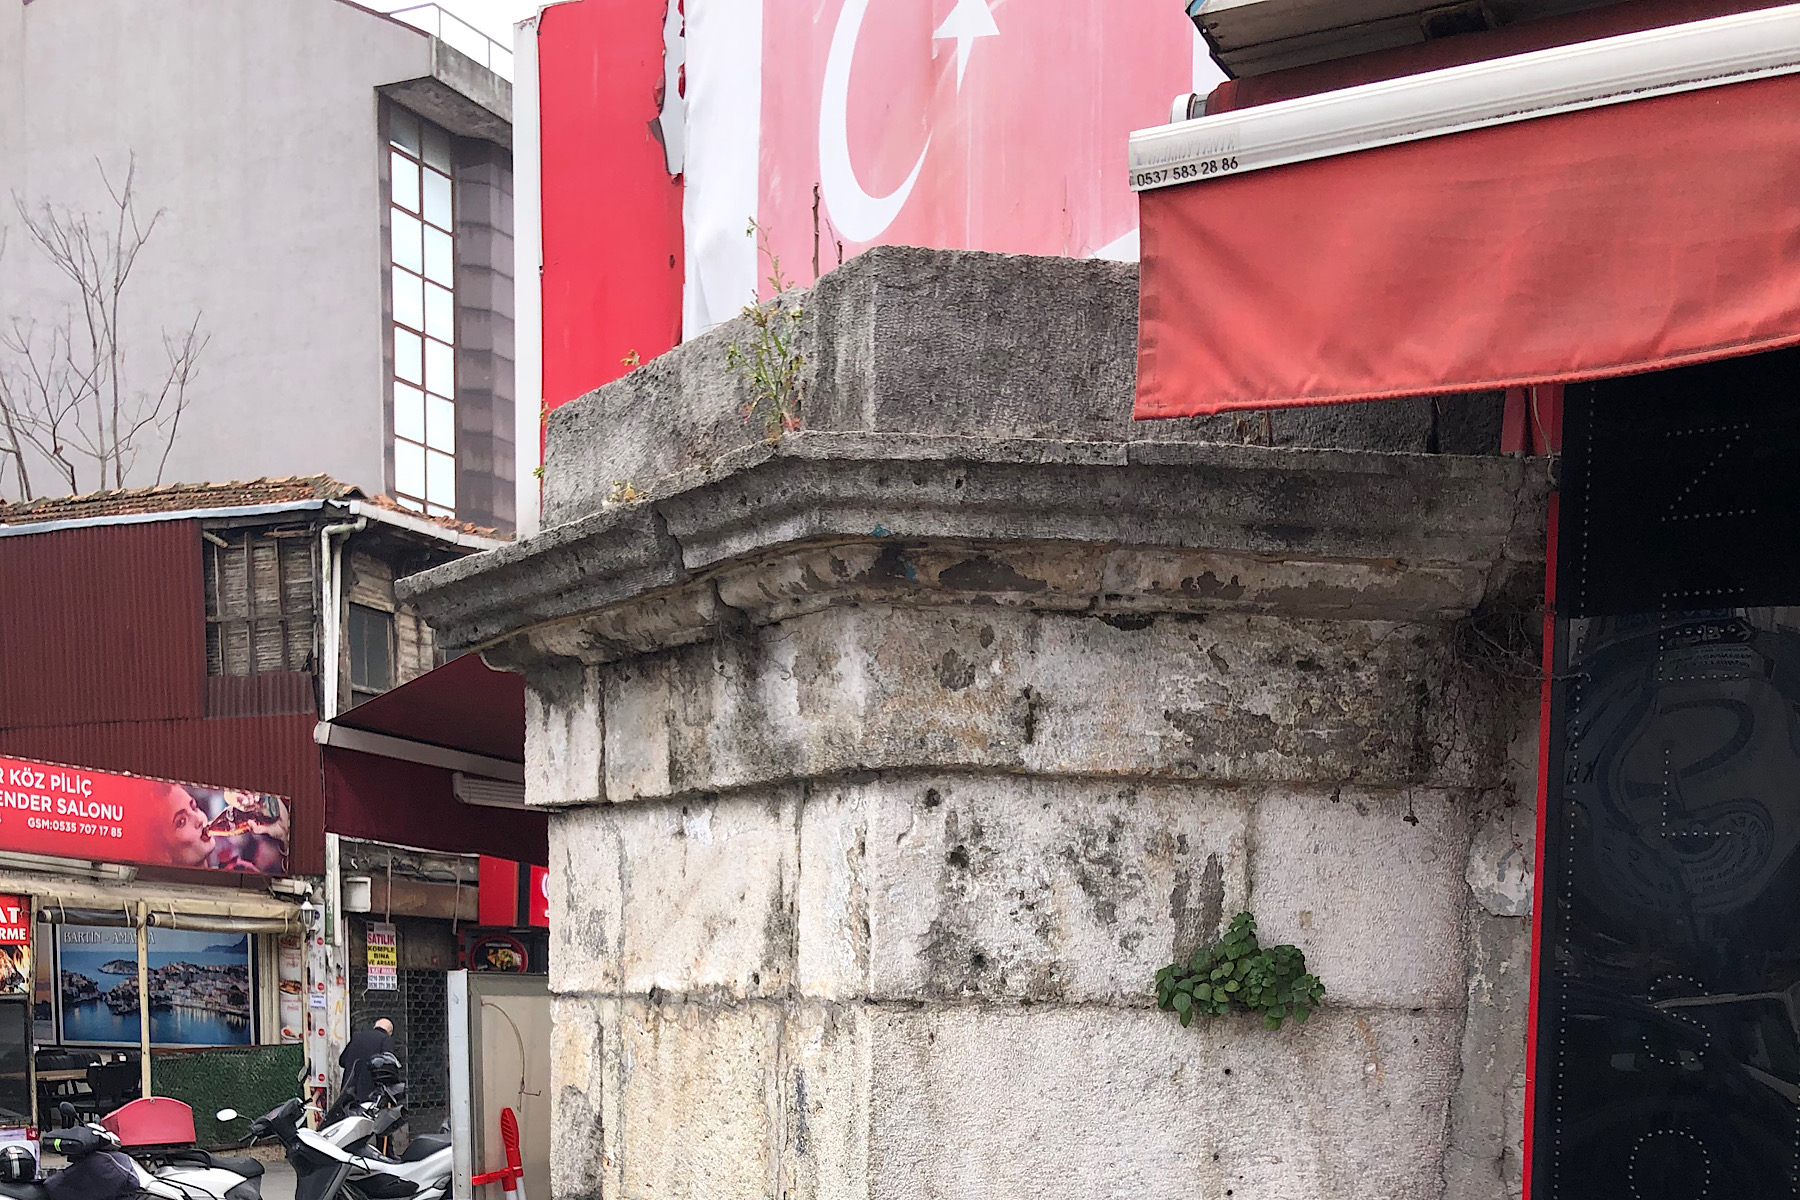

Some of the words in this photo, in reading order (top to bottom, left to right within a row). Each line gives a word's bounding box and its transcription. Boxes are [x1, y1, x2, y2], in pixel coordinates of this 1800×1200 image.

[1137, 170, 1168, 187] 0537
[1173, 164, 1198, 180] 583
[1201, 159, 1218, 175] 28
[1222, 156, 1239, 171] 86
[9, 766, 46, 790] KÖZ
[50, 772, 92, 799] PİLİÇ
[0, 789, 52, 813] NDER
[57, 797, 124, 822] SALONU
[28, 817, 77, 833] GSM:0535
[79, 822, 97, 835] 707
[99, 825, 109, 837] 17
[110, 826, 123, 838] 85
[367, 933, 395, 946] SATILIK
[367, 945, 395, 953] KOMPLE
